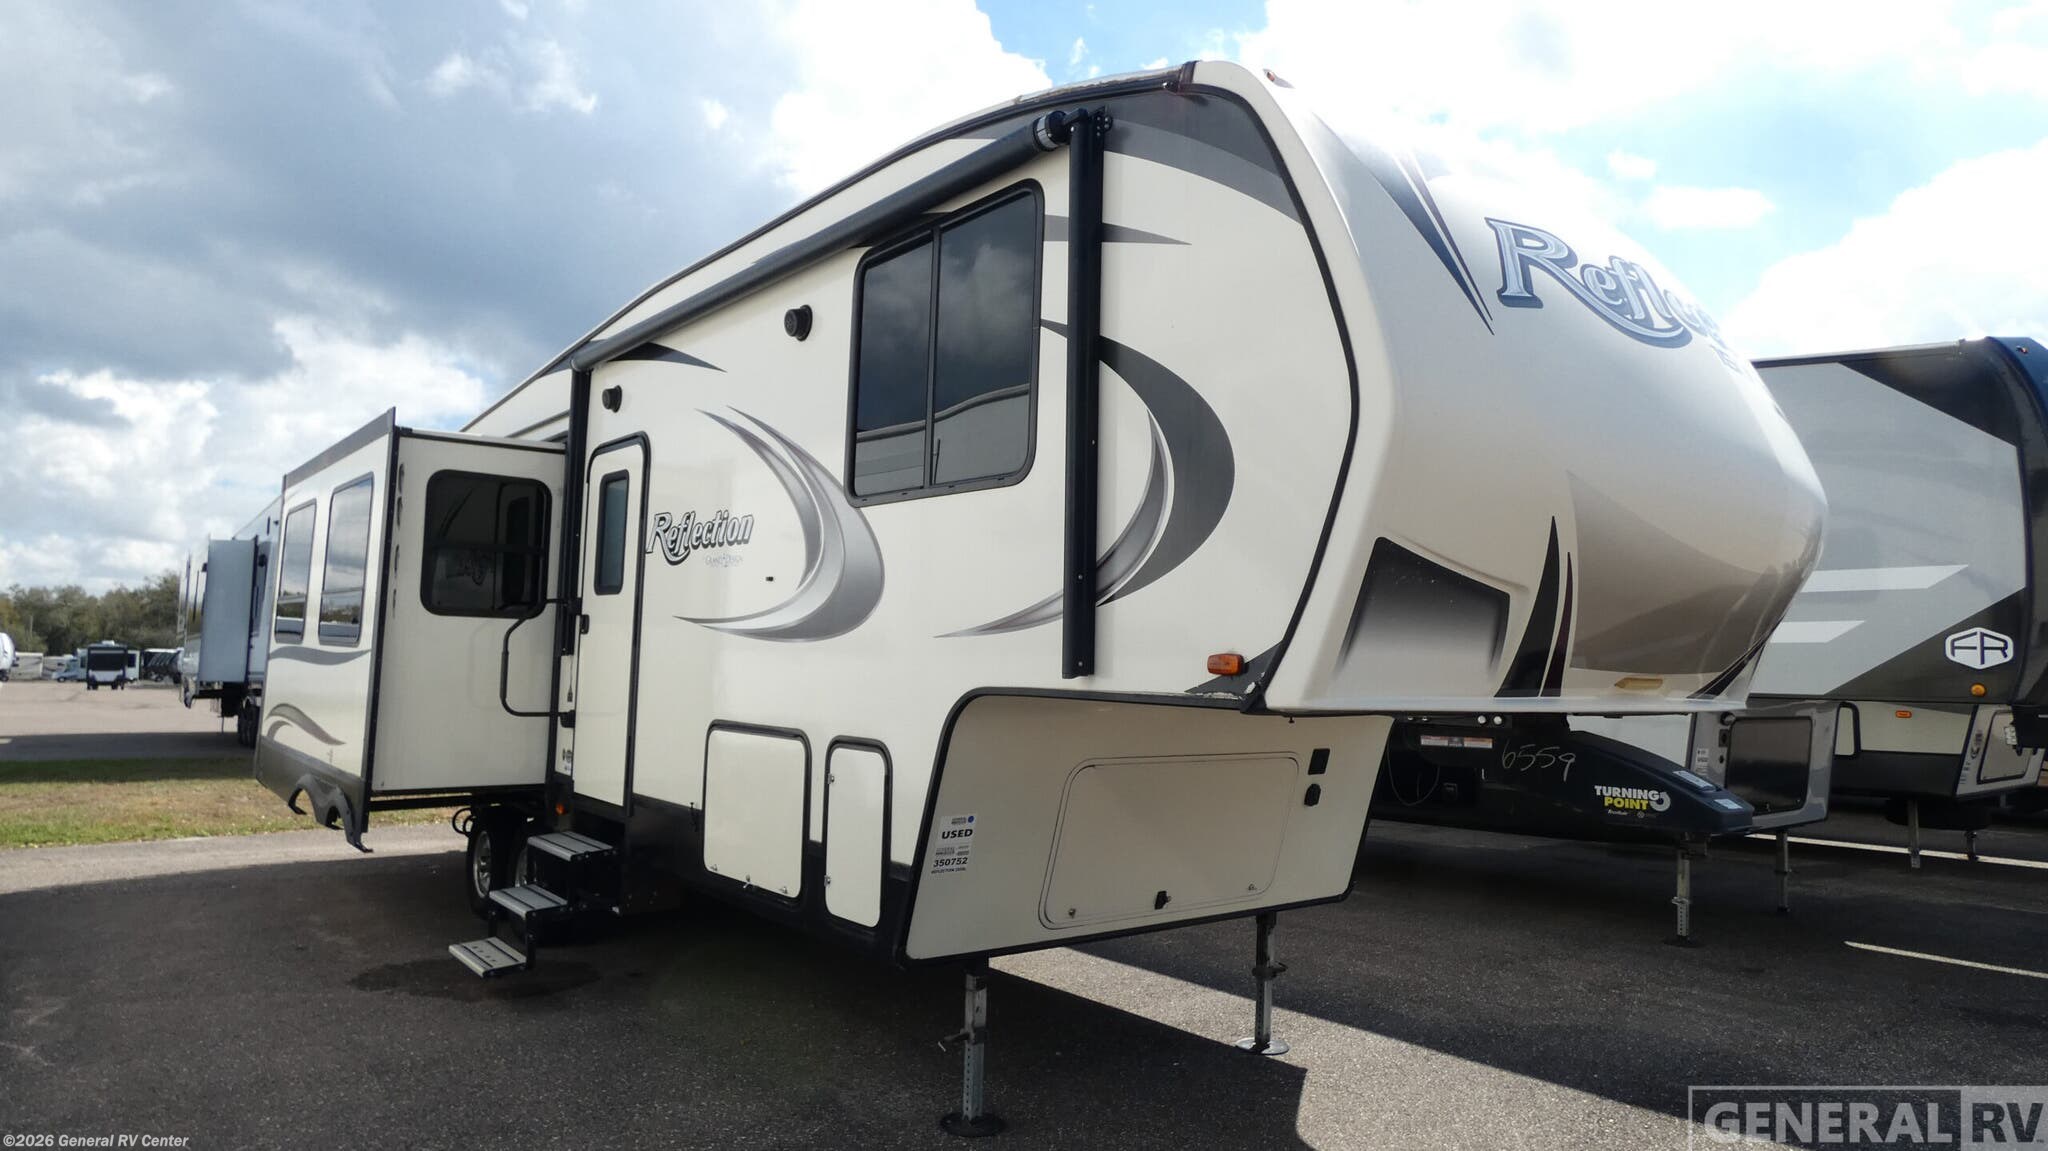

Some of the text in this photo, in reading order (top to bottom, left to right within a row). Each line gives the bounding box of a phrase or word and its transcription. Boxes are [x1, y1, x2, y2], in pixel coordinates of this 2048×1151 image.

[645, 509, 754, 566] Reflection
[1950, 631, 2009, 665] FR
[1594, 785, 1660, 801] TURNING
[1604, 796, 1648, 810] POINT
[941, 829, 973, 840] USED
[933, 857, 968, 867] 350752
